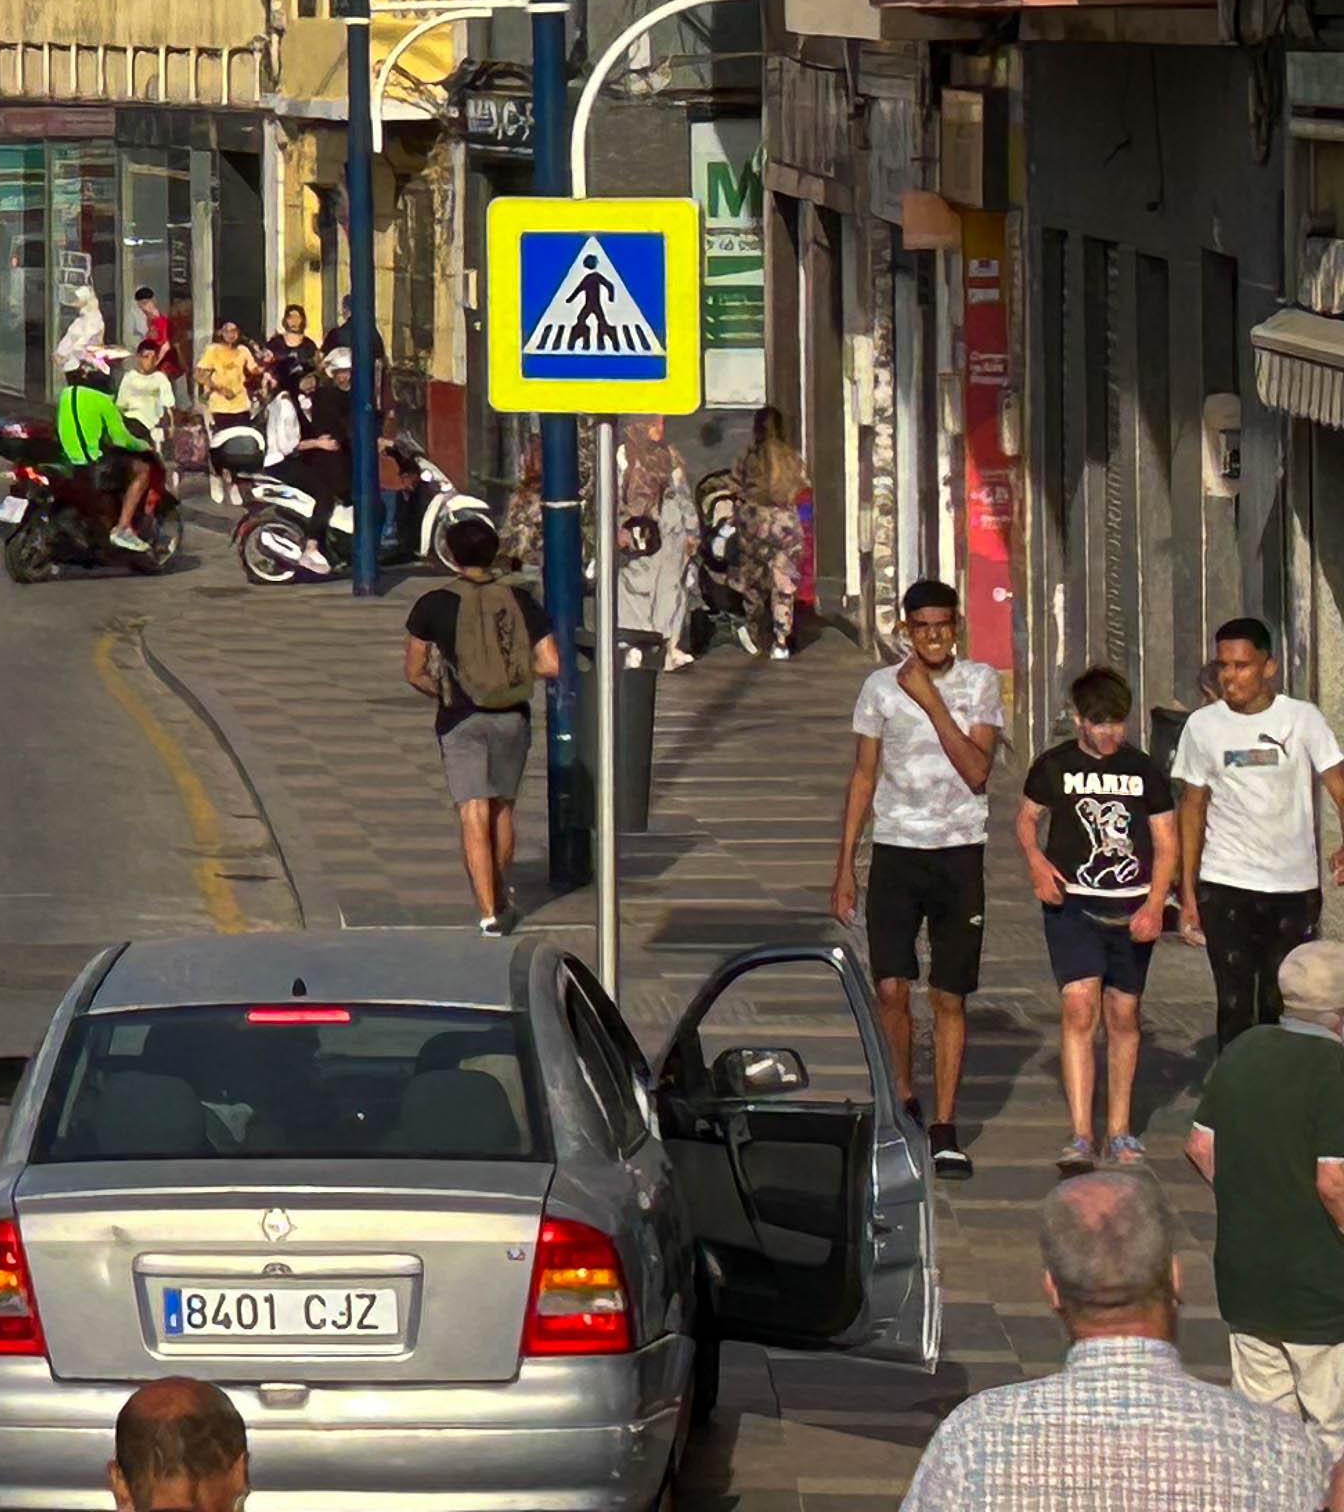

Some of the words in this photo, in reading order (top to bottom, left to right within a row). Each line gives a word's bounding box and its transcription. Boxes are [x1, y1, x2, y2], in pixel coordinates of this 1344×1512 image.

[1063, 772, 1144, 796] MARIO
[186, 1292, 276, 1330] 8401
[303, 1292, 380, 1330] CJZ
